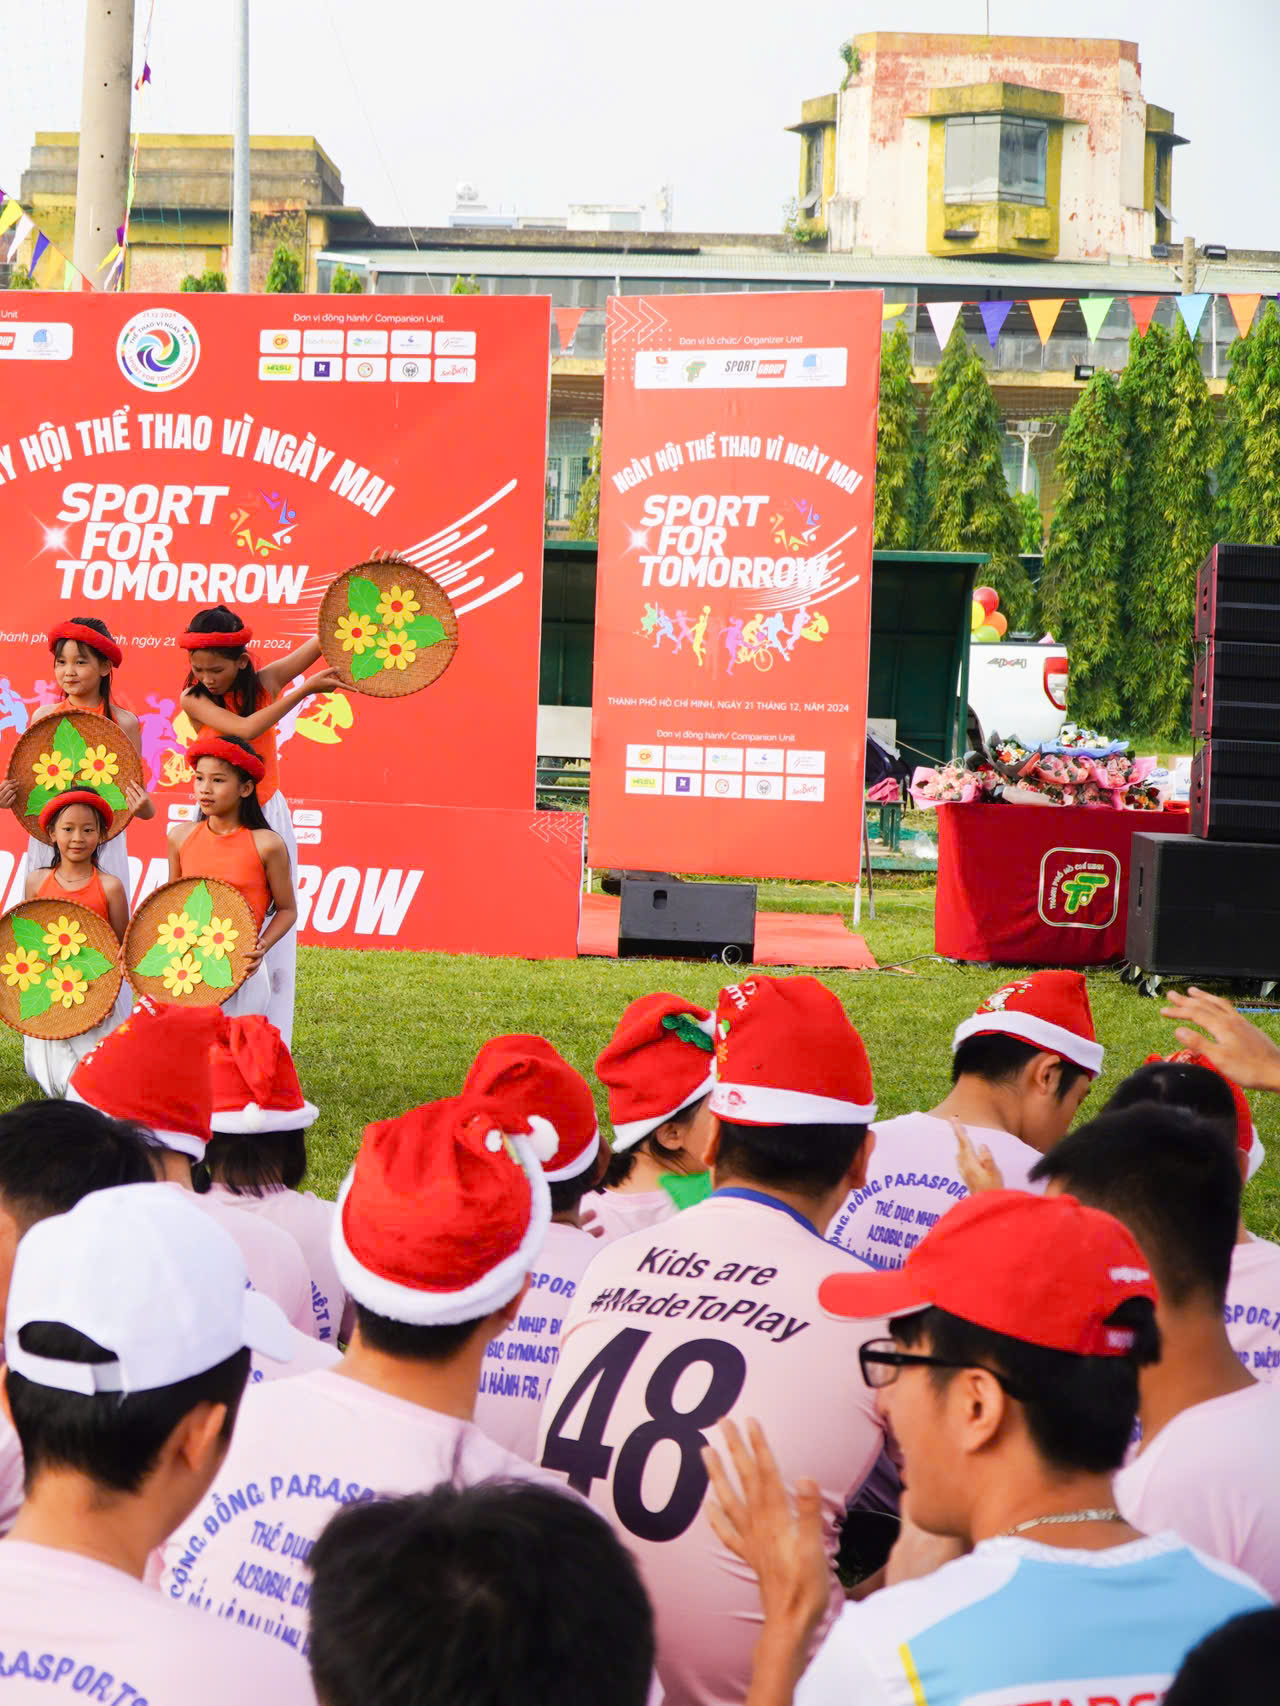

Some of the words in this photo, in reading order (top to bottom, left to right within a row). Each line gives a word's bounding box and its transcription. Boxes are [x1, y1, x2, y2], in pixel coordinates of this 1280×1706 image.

[1, 310, 18, 319] Unit
[294, 314, 311, 322] Đơn
[375, 314, 423, 324] Companion
[426, 315, 444, 323] Unit
[744, 336, 784, 346] Organizer
[786, 336, 803, 344] Unit
[725, 360, 756, 372] SPORT
[759, 365, 785, 375] GROUP
[19, 421, 72, 473] HỘI
[76, 405, 130, 456] THỂ
[137, 413, 212, 450] THAO
[221, 412, 254, 458] VÌ
[254, 426, 336, 483] NGÀY
[329, 458, 395, 517] MAI
[612, 458, 654, 494] NGÀY
[654, 442, 684, 472] HỘI
[685, 432, 717, 461] THỂ
[720, 436, 760, 458] THAO
[766, 435, 784, 461] VÌ
[783, 445, 830, 476] NGÀY
[826, 460, 863, 494] MAI
[56, 482, 230, 525] SPORT
[640, 494, 770, 527] SPORT
[80, 522, 174, 561] FOR
[657, 526, 727, 556] FOR
[56, 559, 309, 605] TOMORROW
[638, 556, 830, 589] TOMORROW
[164, 636, 176, 646] 21
[264, 639, 291, 650] 2024
[639, 697, 656, 707] PHỐ
[690, 700, 715, 709] MINH,
[745, 701, 754, 710] 21
[790, 703, 801, 712] 12,
[827, 703, 849, 712] 2024
[732, 732, 776, 742] Companion
[779, 733, 795, 742] Unit
[848, 1180, 882, 1214] ĐỒNG
[885, 1173, 968, 1200] PARASPOR
[868, 1224, 903, 1248] AEROBIC
[637, 1246, 710, 1278] Kids
[714, 1262, 778, 1286] are
[518, 1316, 547, 1338] NHỊP
[588, 1287, 810, 1343] #MadeToPlay
[506, 1343, 559, 1365] GYMNAST
[488, 1367, 519, 1397] HÀNH
[541, 1327, 747, 1543] 48
[170, 1535, 207, 1599] CỘNG
[203, 1482, 265, 1537] ĐỒNG
[270, 1474, 376, 1505] PARASP
